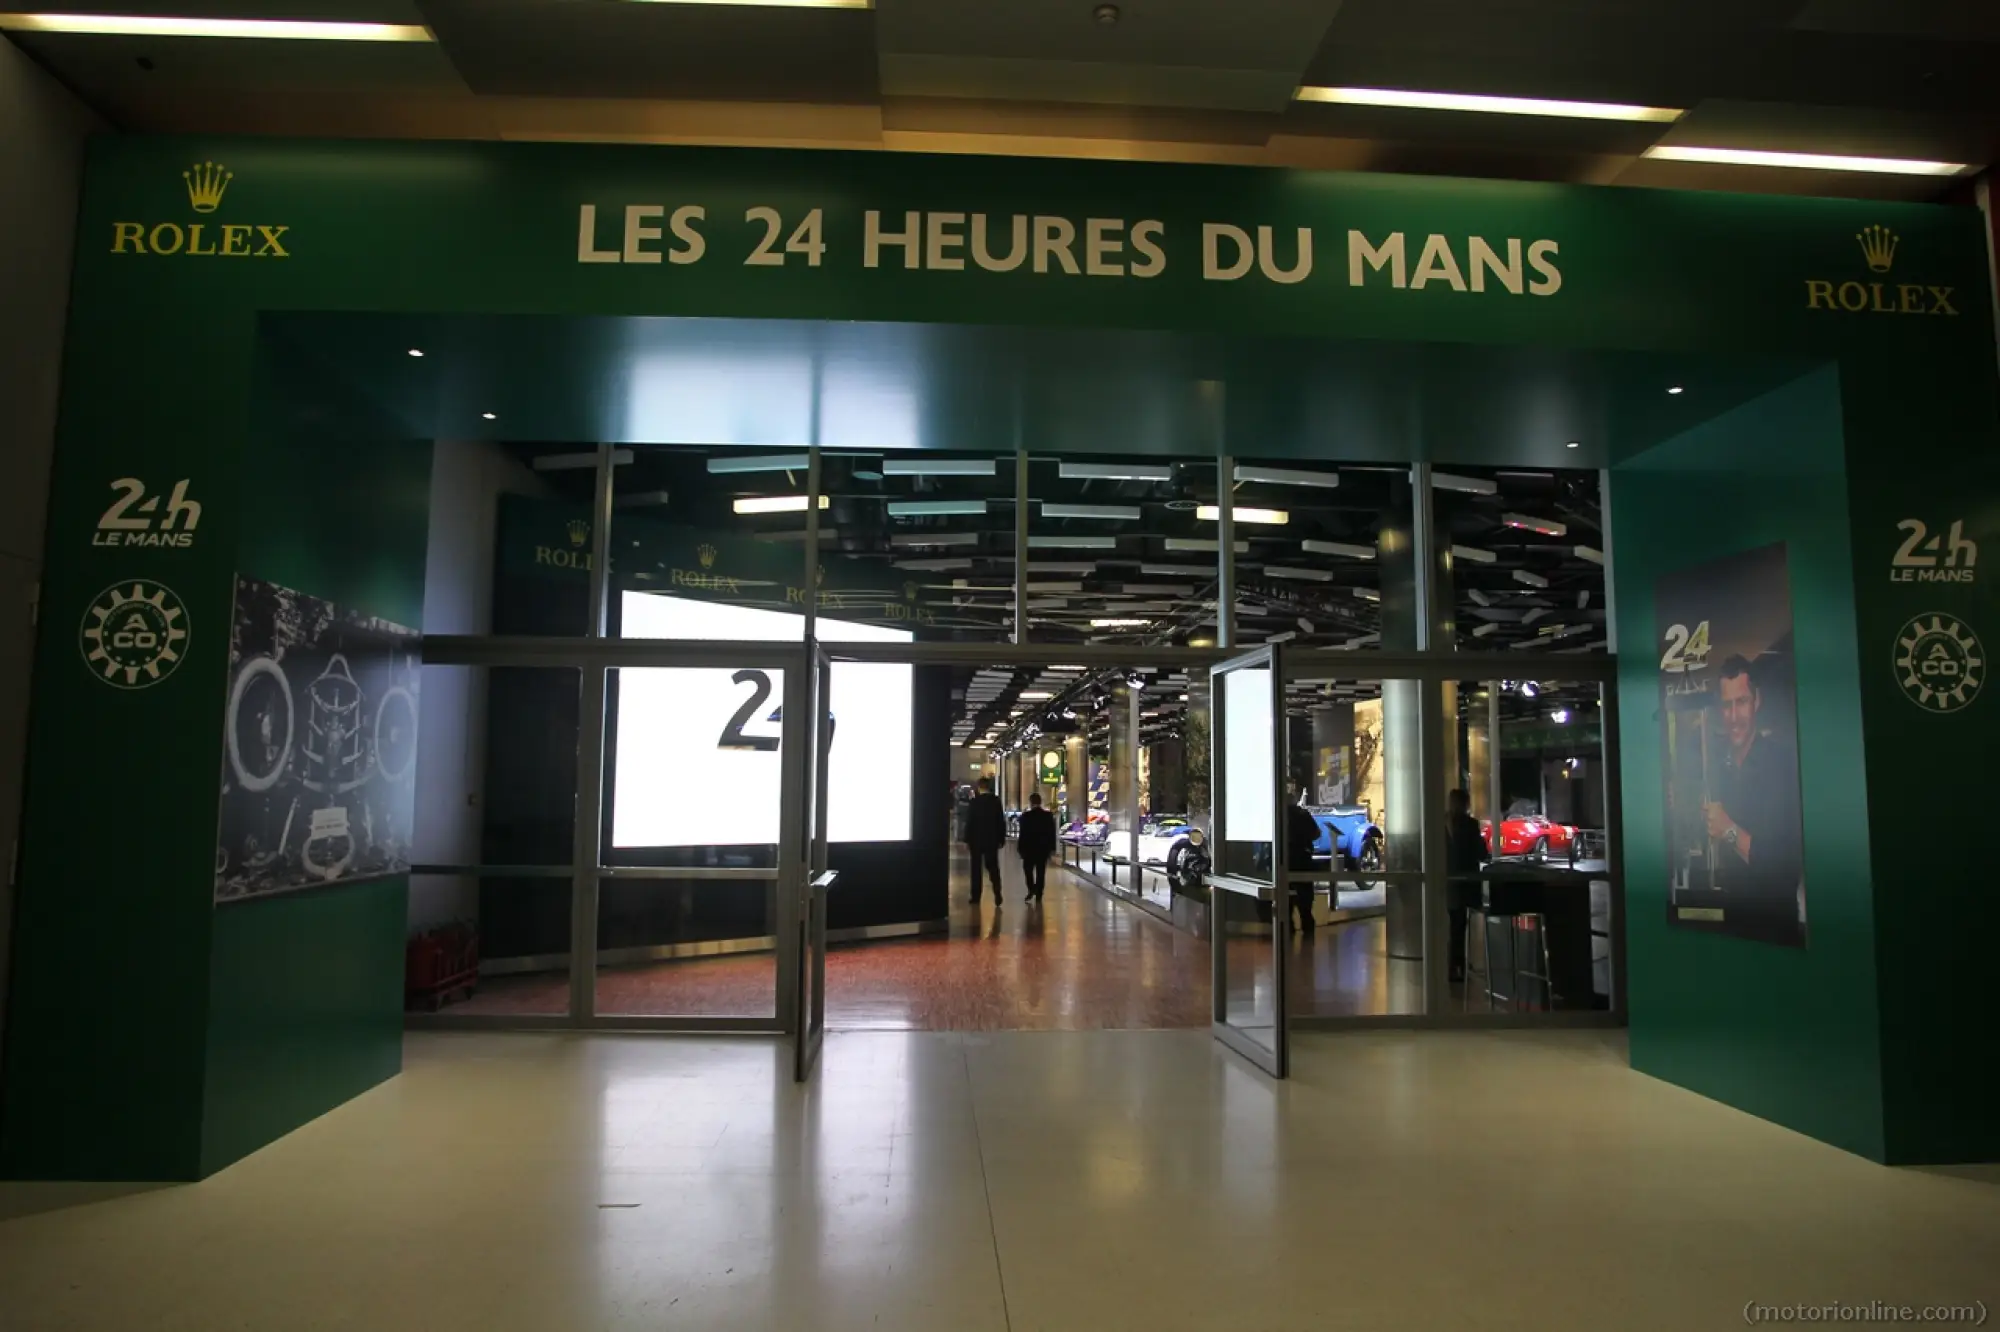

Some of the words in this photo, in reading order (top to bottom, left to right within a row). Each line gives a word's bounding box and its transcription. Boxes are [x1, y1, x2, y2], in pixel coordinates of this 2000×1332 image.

[110, 222, 290, 257] ROLEX
[578, 204, 706, 264] LES
[743, 206, 826, 267] 24
[864, 210, 1166, 279] HEURES
[1202, 222, 1313, 284] DU
[1348, 229, 1563, 296] MANS
[1804, 280, 1960, 316] ROLEX
[92, 532, 121, 547] LE
[124, 532, 193, 548] MANS
[535, 545, 615, 574] ROL
[671, 568, 741, 594] ROLEX
[1890, 569, 1915, 582] LE
[1917, 569, 1974, 582] MANS
[784, 586, 845, 610] ROEX
